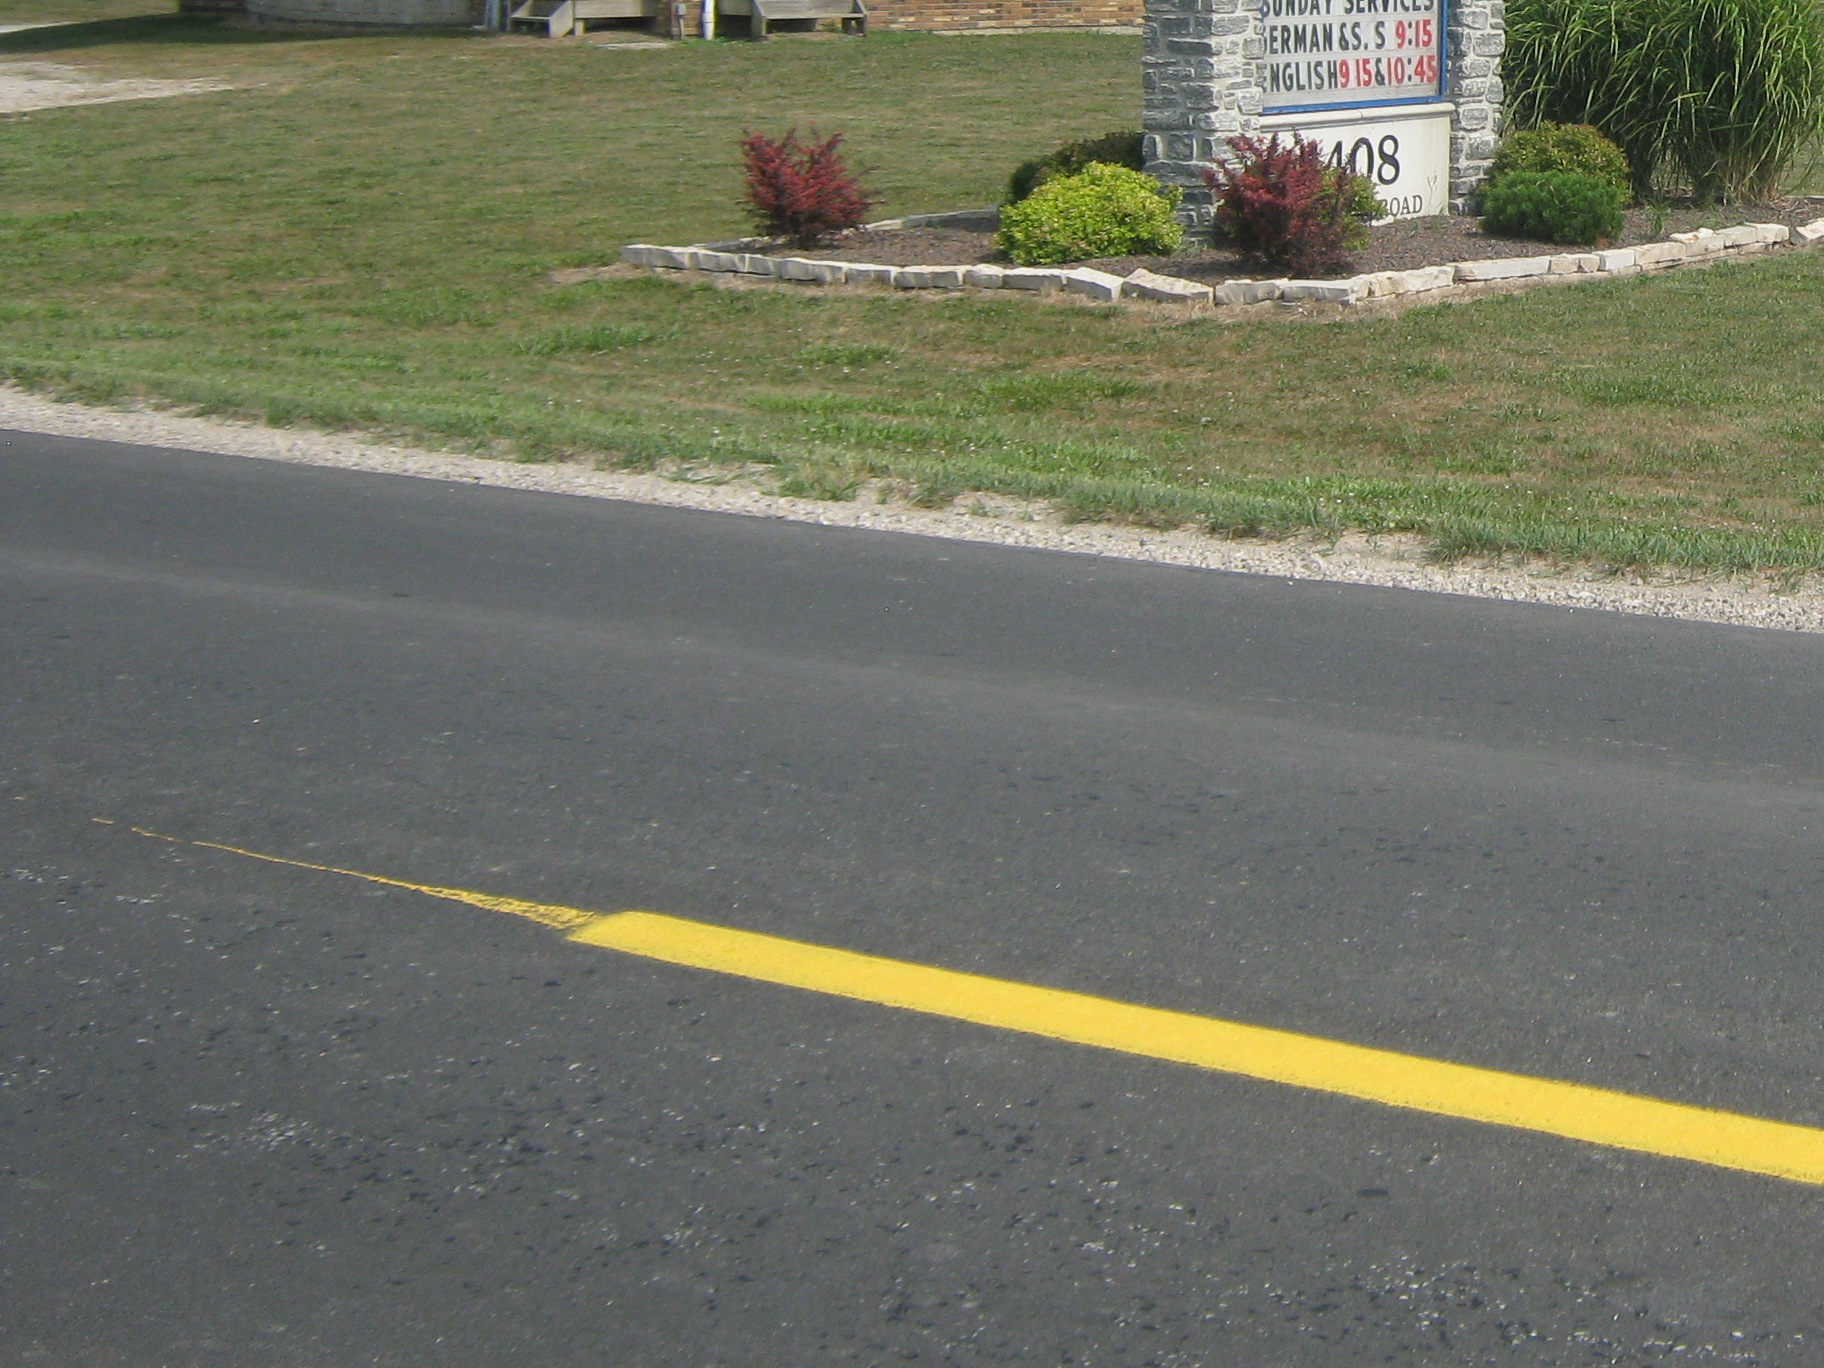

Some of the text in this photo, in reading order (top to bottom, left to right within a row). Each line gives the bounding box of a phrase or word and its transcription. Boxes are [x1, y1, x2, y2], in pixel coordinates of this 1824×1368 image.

[1264, 23, 1333, 54] ERMAN
[1395, 19, 1433, 49] 9:15
[1387, 54, 1438, 85] 10:45
